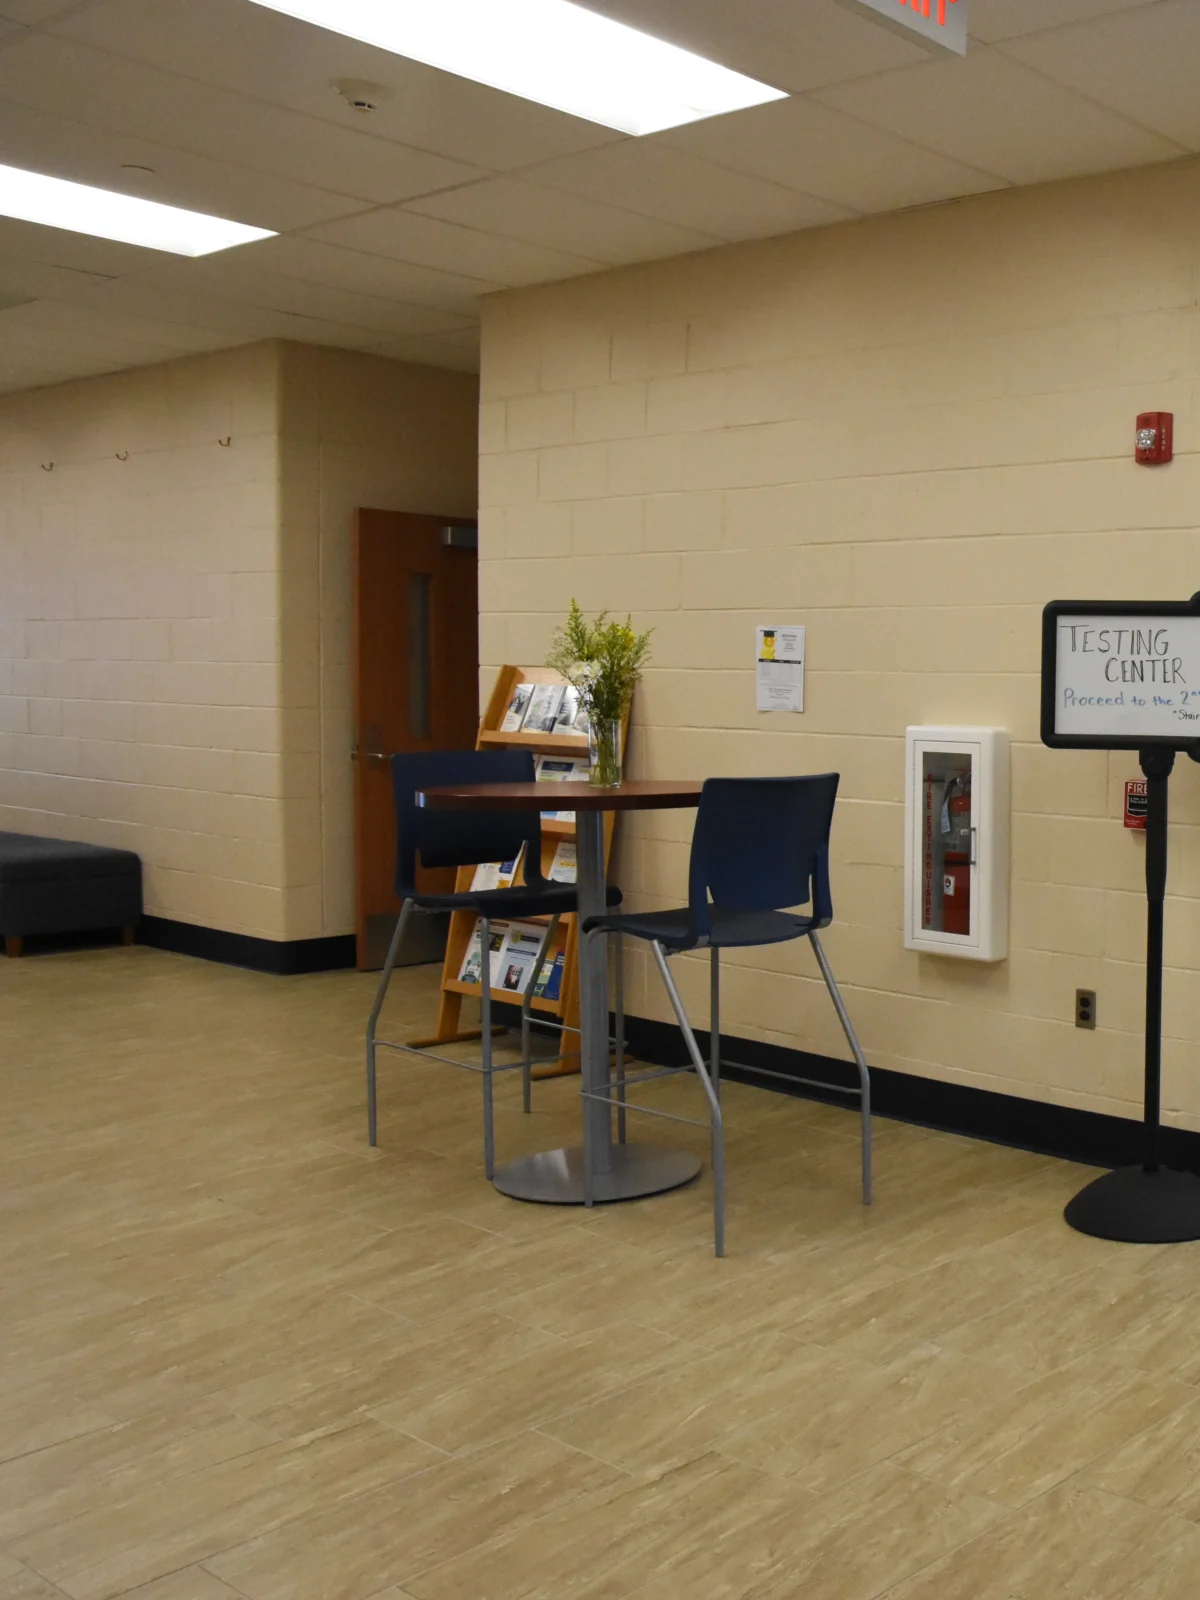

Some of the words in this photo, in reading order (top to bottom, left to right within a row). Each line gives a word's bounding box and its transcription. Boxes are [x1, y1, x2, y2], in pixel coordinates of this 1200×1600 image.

[1060, 624, 1169, 656] TESTING
[1104, 657, 1187, 684] CENTER
[1063, 687, 1125, 708] Proceed
[1131, 695, 1146, 706] to
[1152, 695, 1174, 706] the
[1127, 782, 1147, 794] FIRE
